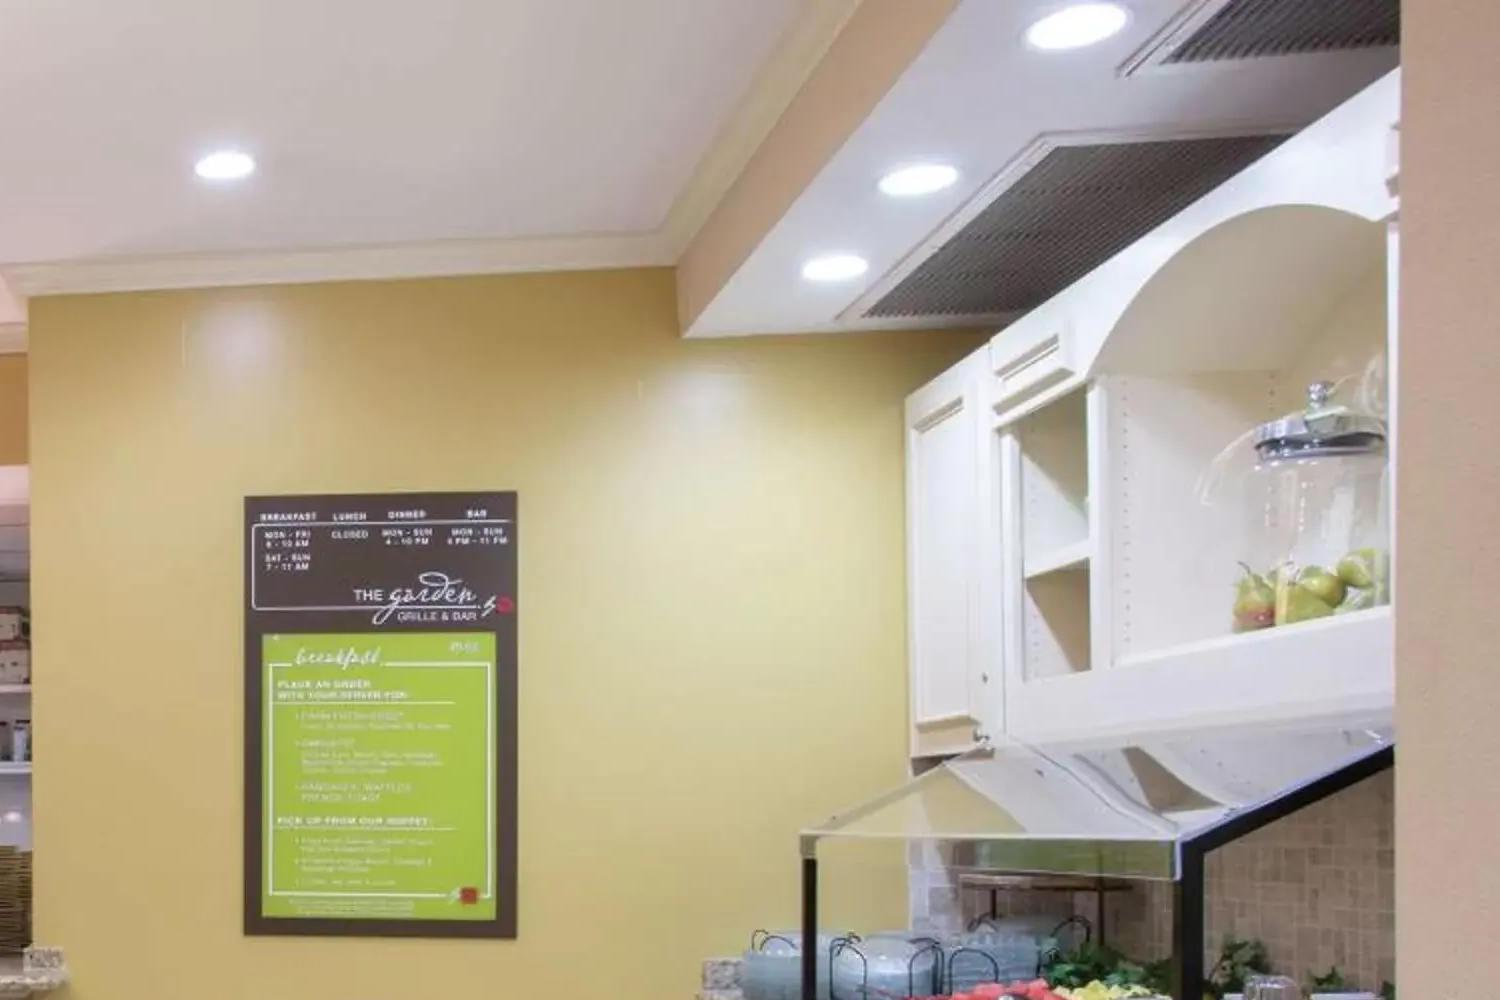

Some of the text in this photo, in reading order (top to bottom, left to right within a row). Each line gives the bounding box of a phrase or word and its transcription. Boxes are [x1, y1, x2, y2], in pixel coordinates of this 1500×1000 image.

[260, 511, 317, 521] BREAKFAST
[332, 511, 367, 521] LUNCH
[387, 509, 427, 519] DINNER
[466, 509, 488, 519] BAR
[264, 530, 285, 539] MON
[295, 530, 311, 538] FRI
[331, 530, 369, 539] CLOSED
[415, 537, 429, 545] PM
[455, 537, 470, 545] PM
[493, 536, 508, 545] PM
[352, 571, 477, 625] THE garden
[397, 611, 478, 622] GRILLE & BAR
[294, 645, 382, 671] breakfast
[315, 679, 331, 689] AN
[333, 679, 371, 689] ORDER
[277, 690, 305, 700] WITH
[277, 816, 303, 826] PICK
[306, 816, 323, 826] UP
[325, 816, 356, 827] FROM
[359, 816, 383, 826] OUR
